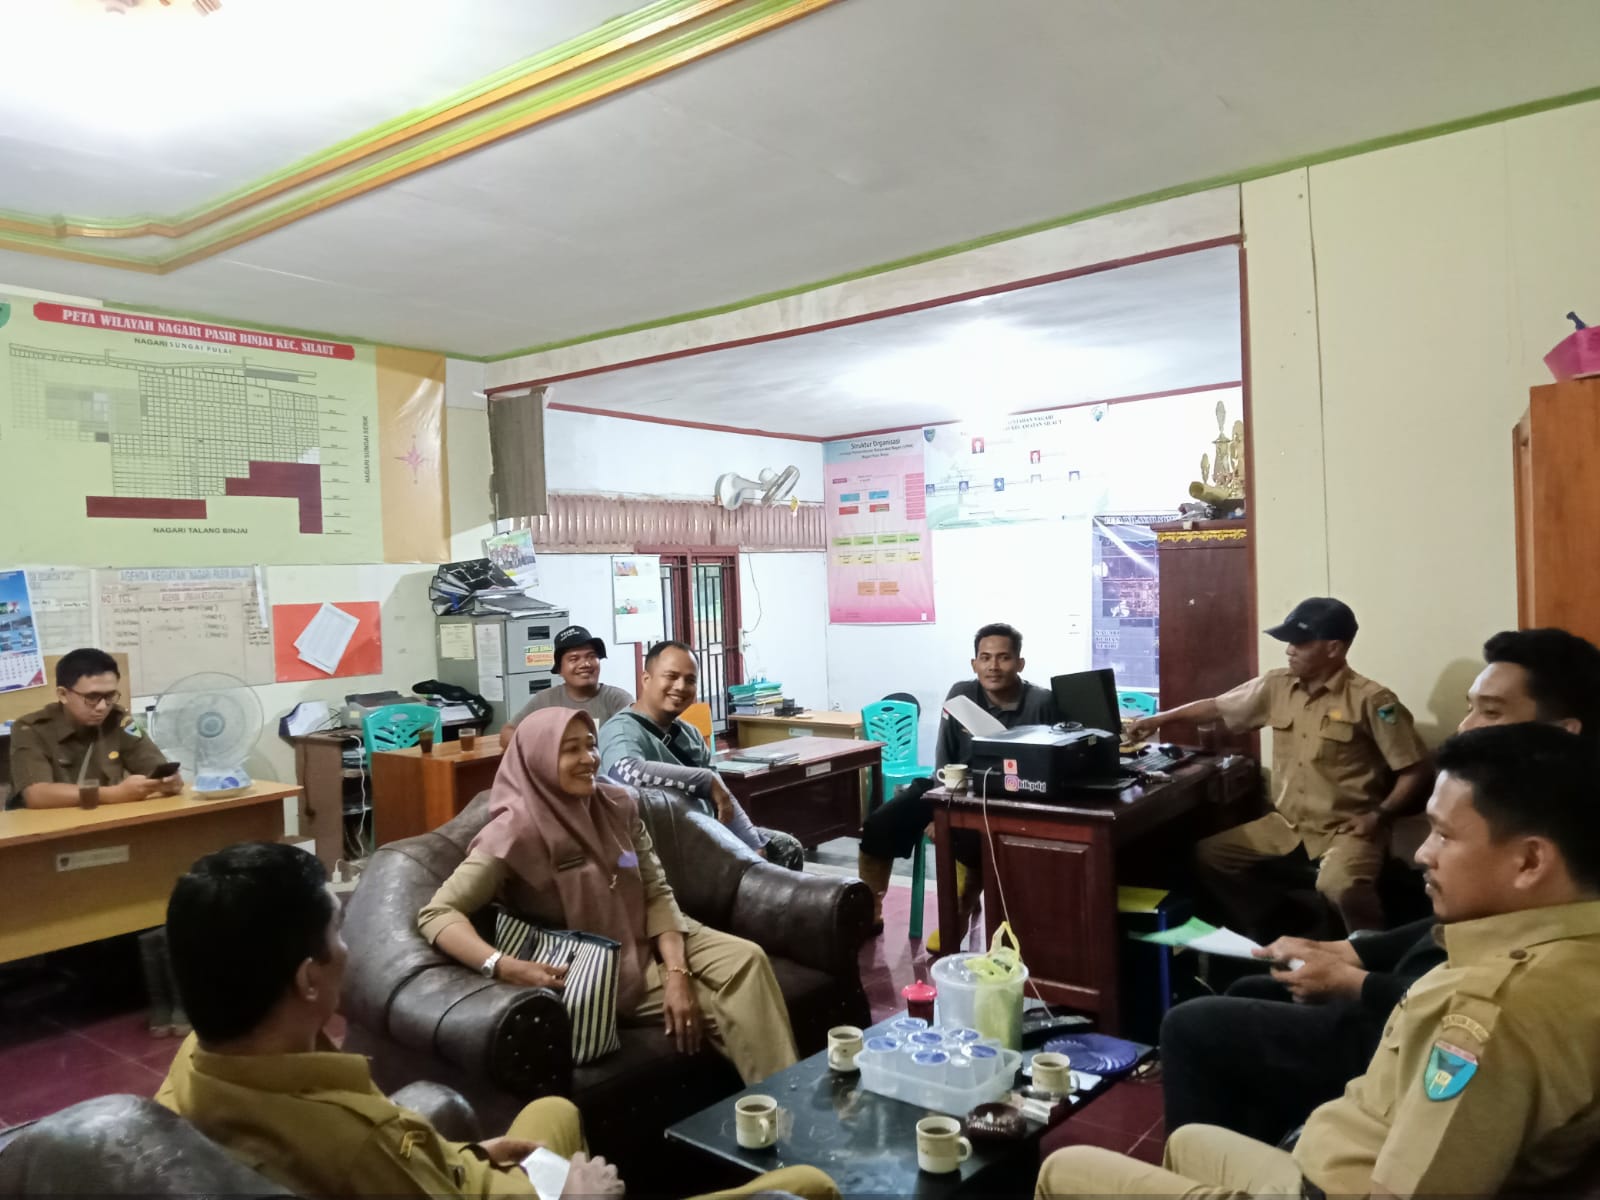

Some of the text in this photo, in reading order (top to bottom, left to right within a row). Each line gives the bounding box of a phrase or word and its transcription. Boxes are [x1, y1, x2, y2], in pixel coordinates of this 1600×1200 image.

[62, 308, 335, 356] PETA WILAYAH NAGARI PASIR BINJAI KEC. SILAUT
[134, 337, 168, 347] NAGARI
[169, 342, 204, 351] SUNGAI
[188, 527, 221, 535] TALANG
